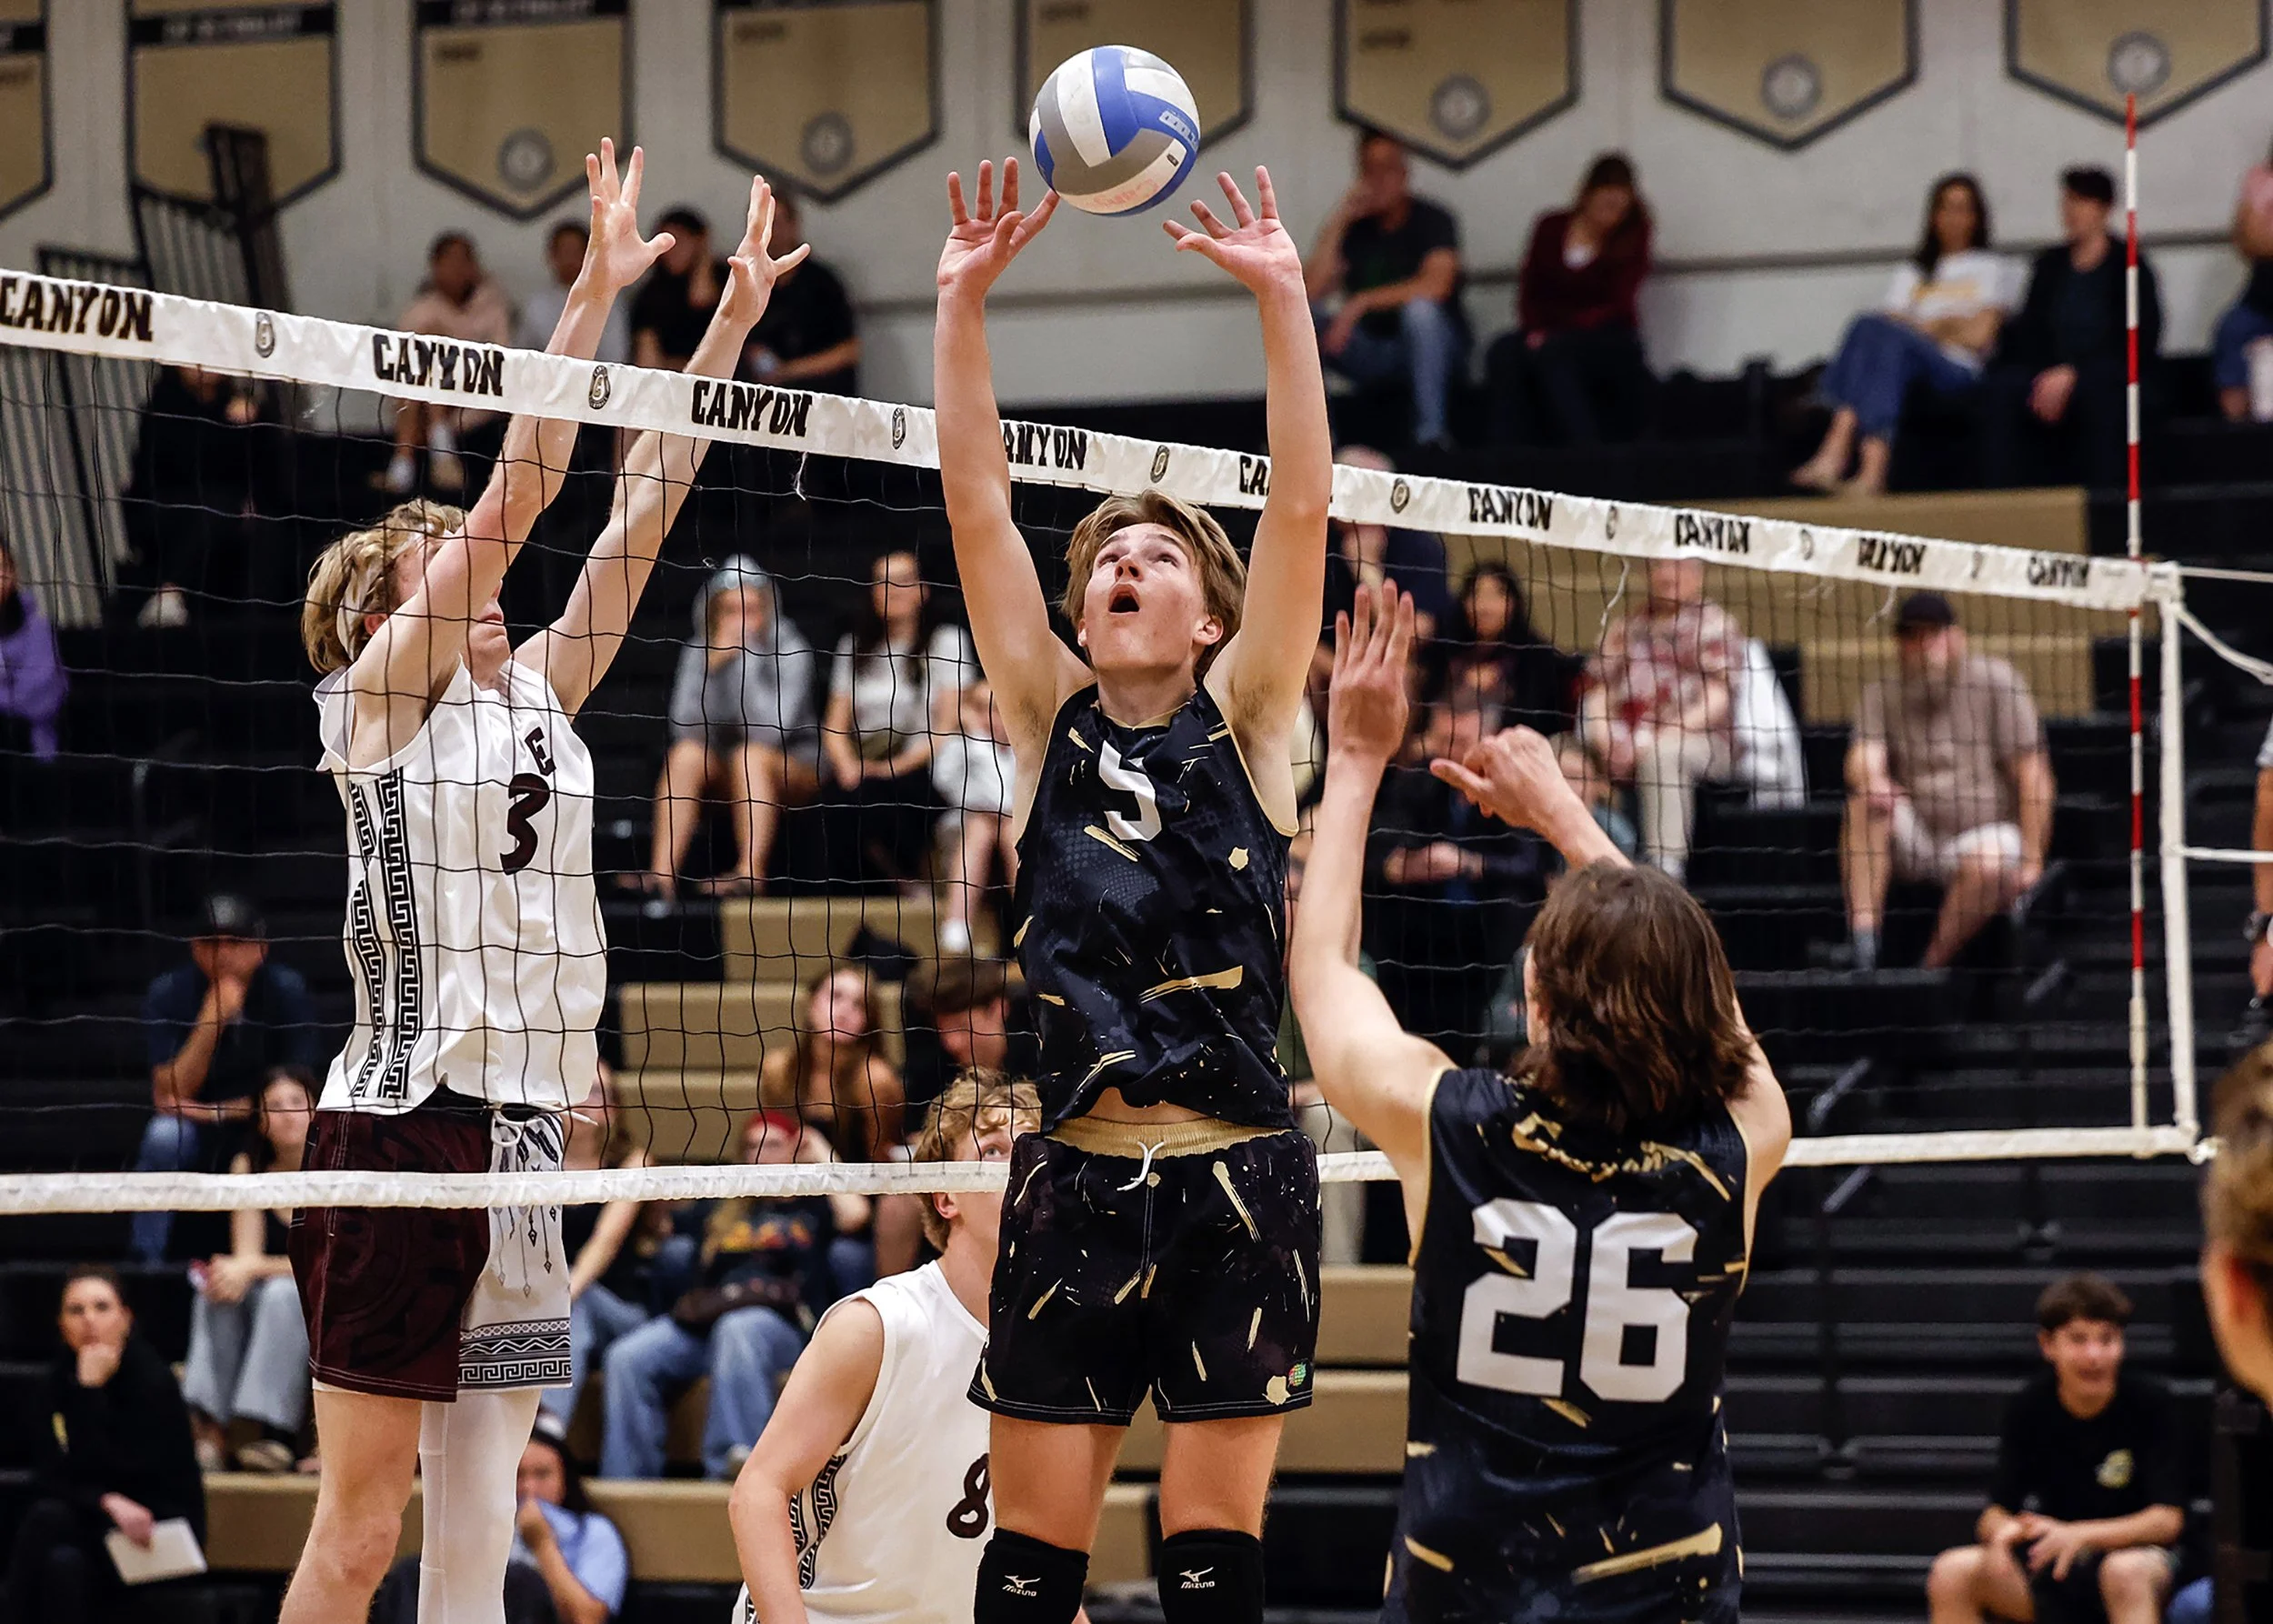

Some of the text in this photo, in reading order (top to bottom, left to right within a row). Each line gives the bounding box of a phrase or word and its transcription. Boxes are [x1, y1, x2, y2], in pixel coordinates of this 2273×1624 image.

[0, 276, 154, 342] CANYON
[372, 333, 505, 396] CANYON
[690, 380, 813, 437] CANYON
[1003, 422, 1087, 470] ANYON
[1467, 486, 1554, 531] CANYON
[500, 772, 550, 876] 3
[1457, 1198, 1698, 1403] 26
[946, 1452, 990, 1539] 8
